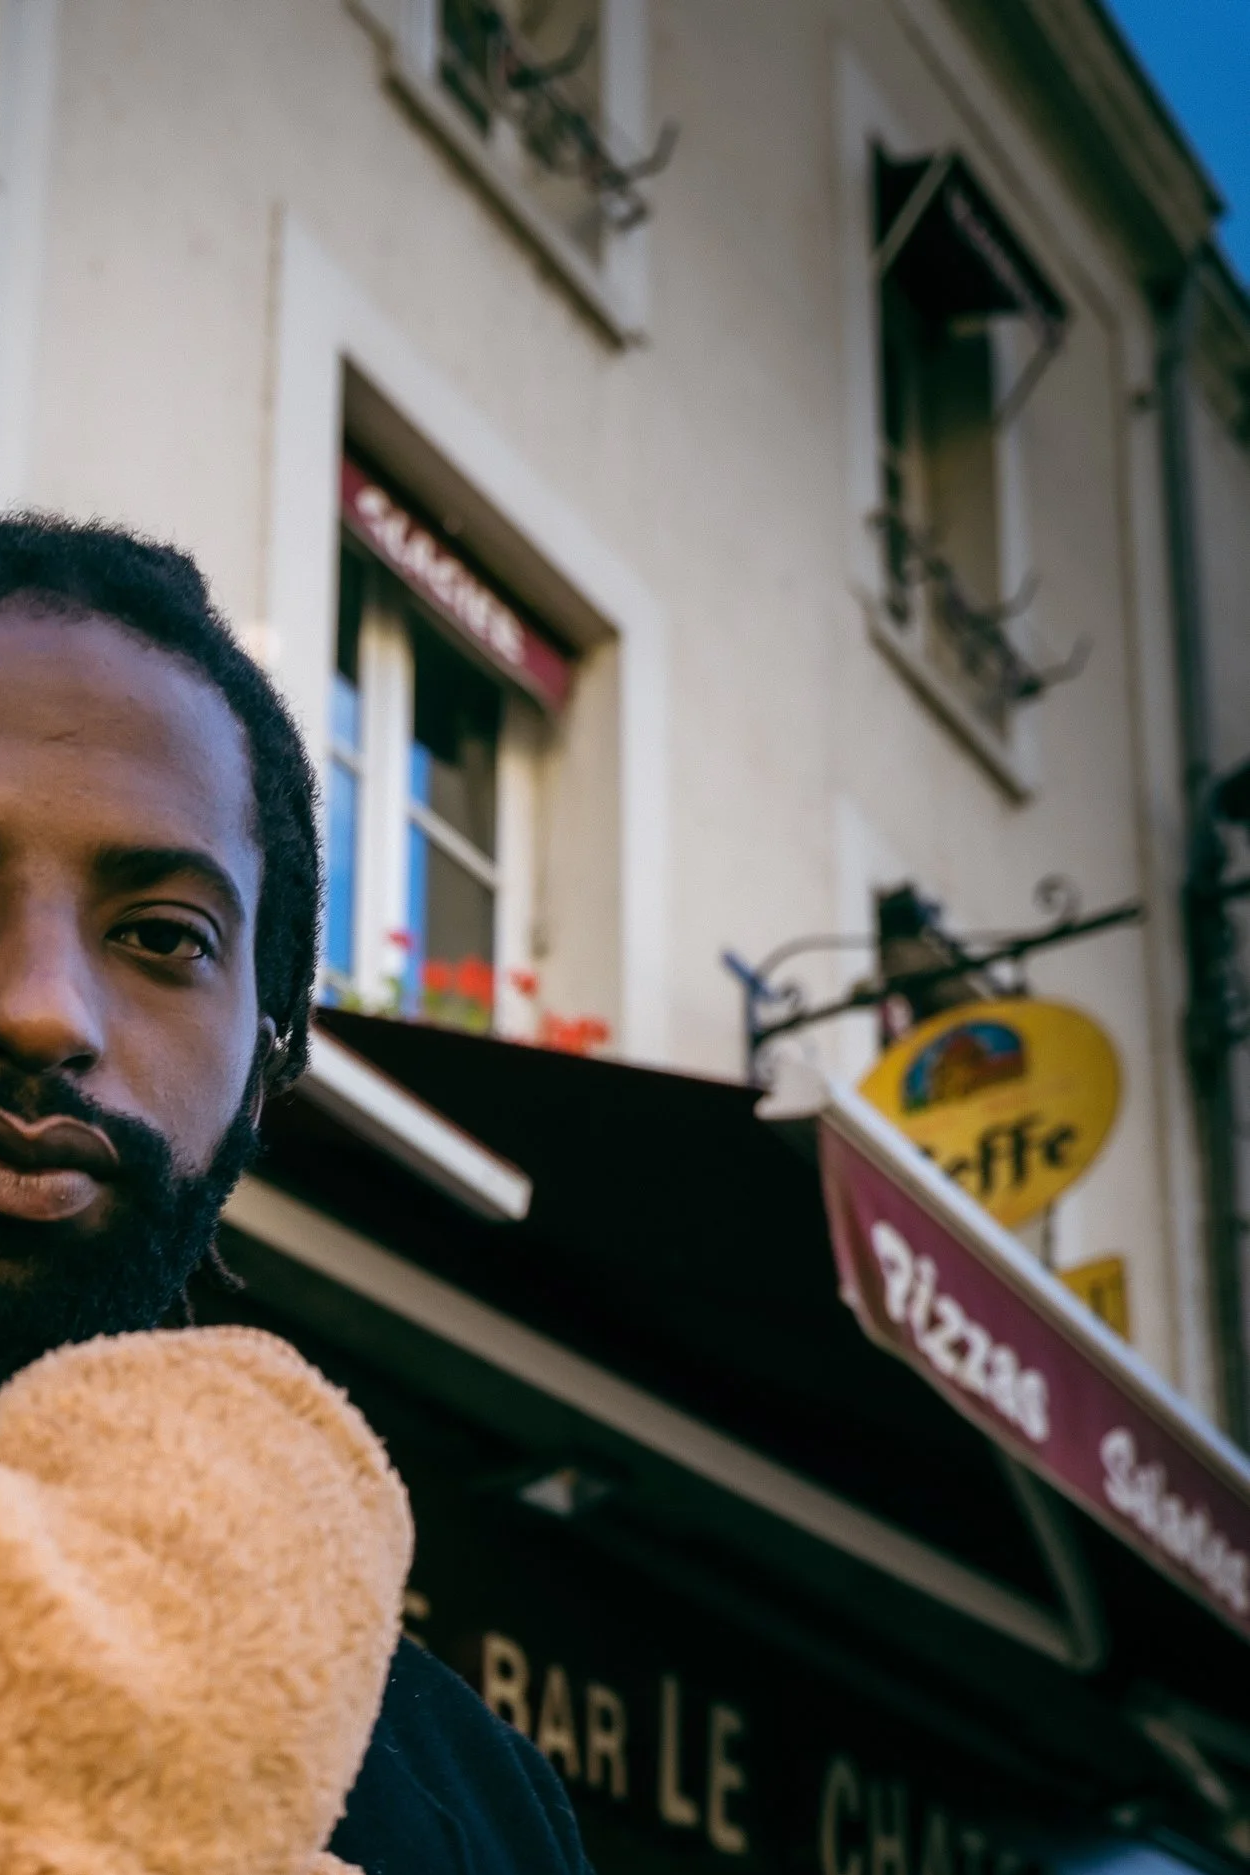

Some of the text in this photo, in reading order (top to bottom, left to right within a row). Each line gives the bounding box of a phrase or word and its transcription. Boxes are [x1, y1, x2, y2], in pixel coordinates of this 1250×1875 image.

[871, 1219, 1049, 1442] Pizzas
[482, 1630, 628, 1798] BAR
[658, 1672, 748, 1856] LE
